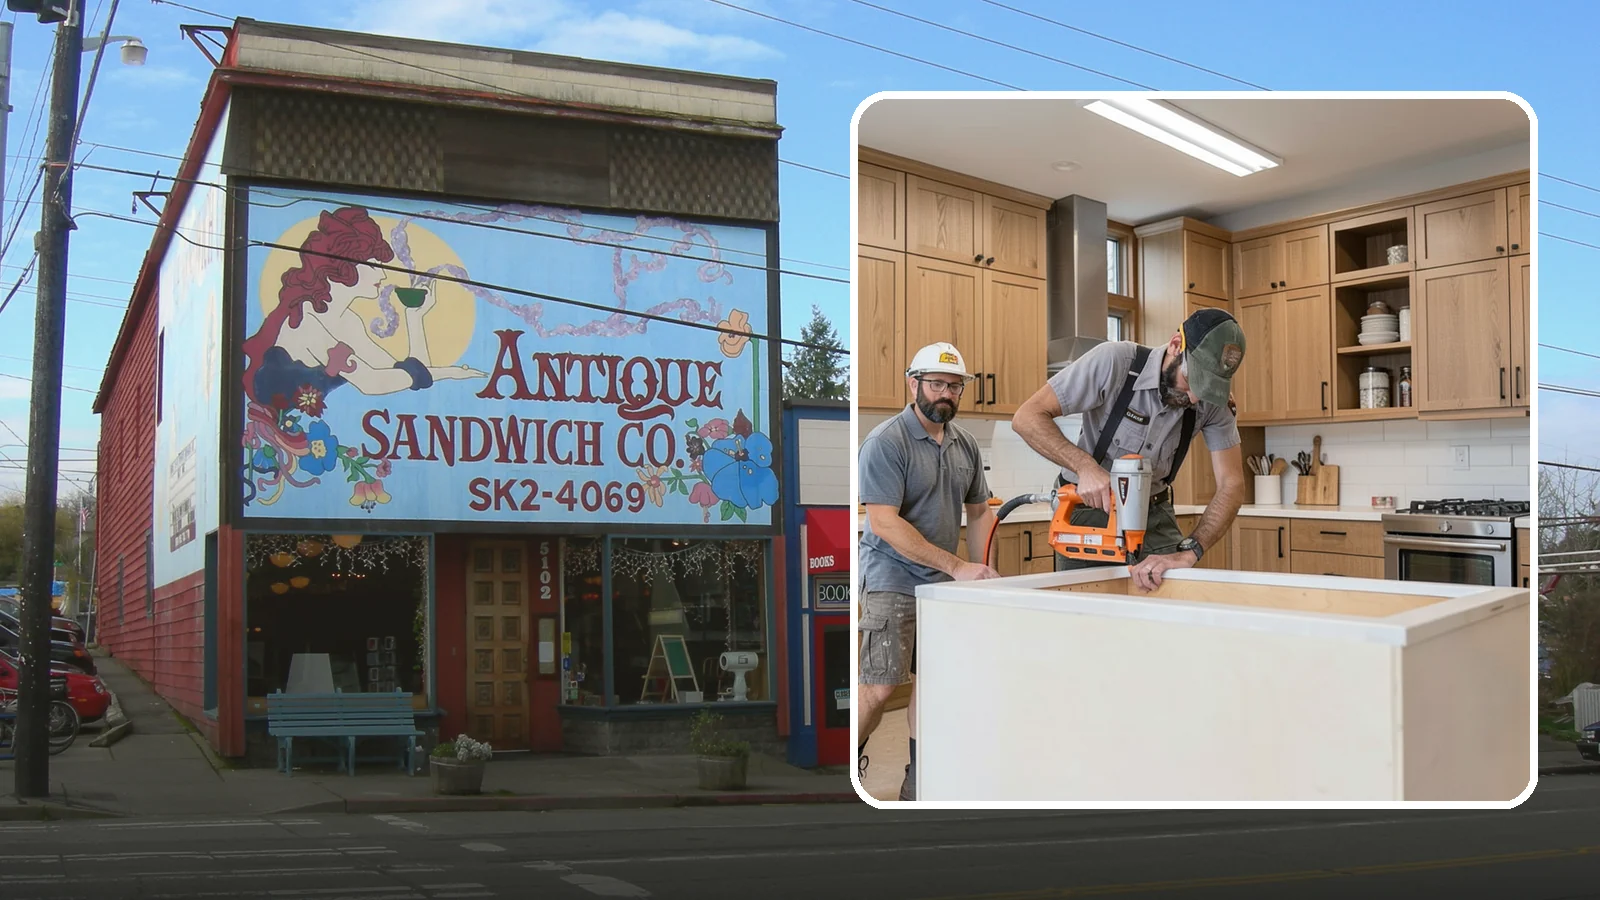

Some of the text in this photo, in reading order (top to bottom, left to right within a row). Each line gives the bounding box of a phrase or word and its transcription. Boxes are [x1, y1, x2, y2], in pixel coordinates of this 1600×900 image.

[476, 329, 724, 420] ANTIQUE
[361, 408, 685, 469] SANDWICH CO.
[468, 477, 646, 513] SK2-4069
[540, 542, 552, 600] 5102
[809, 555, 835, 569] BOOKS
